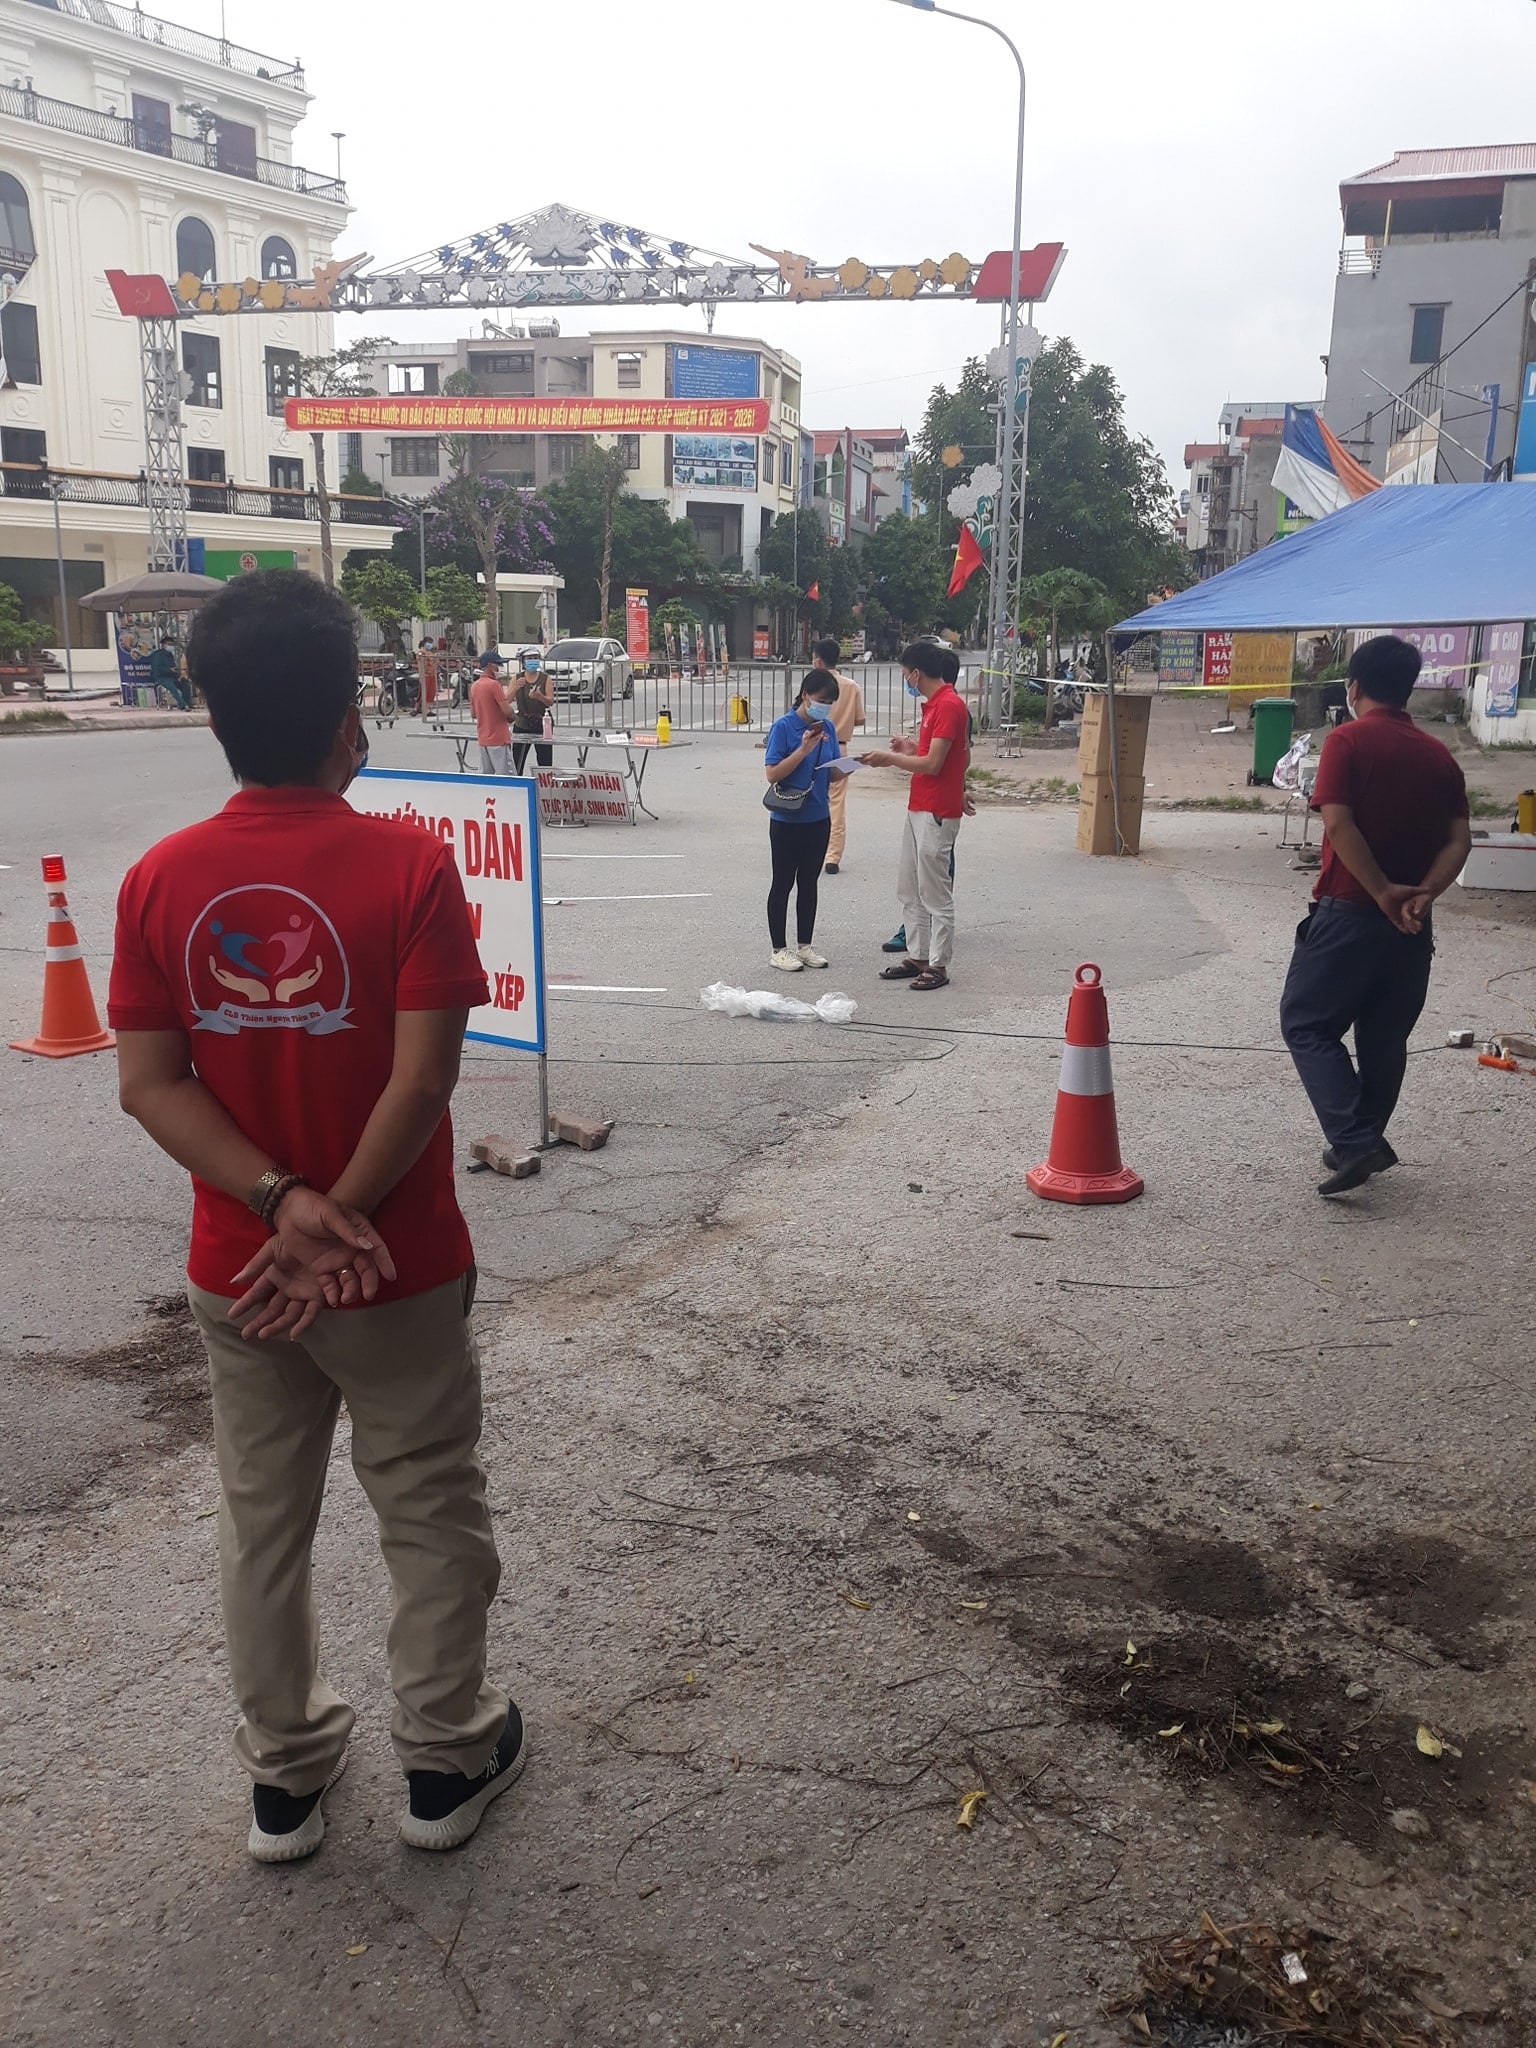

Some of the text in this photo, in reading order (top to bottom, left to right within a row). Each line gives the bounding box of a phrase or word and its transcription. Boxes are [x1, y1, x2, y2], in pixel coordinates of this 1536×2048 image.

[359, 407, 370, 424] TRI
[371, 401, 380, 424] CẢ
[381, 403, 399, 424] NƯỚC
[409, 401, 423, 424] BẦU
[434, 407, 447, 428] ĐẠI
[447, 400, 463, 425] BIỂU
[464, 401, 483, 426] QUỐC
[484, 403, 496, 428] HỘI
[517, 407, 527, 425] XV
[528, 403, 537, 425] VÀ
[538, 407, 550, 429] ĐẠI
[551, 400, 568, 426] BIỂU
[569, 403, 581, 429] HỘI
[582, 401, 602, 425] ĐỒNG
[603, 403, 624, 425] NHÂN
[624, 404, 640, 425] DÂN
[641, 404, 656, 425] CÁC
[657, 402, 672, 425] CẤP
[673, 404, 698, 430] NHIỆM
[698, 404, 709, 426] KỲ
[709, 408, 727, 426] 2021
[733, 408, 755, 427] 2026!
[1174, 656, 1194, 668] KÍNH
[589, 773, 621, 794] NHẬN
[587, 800, 607, 816] SINH
[607, 802, 626, 820] HOẠT
[464, 797, 523, 882] DẪN
